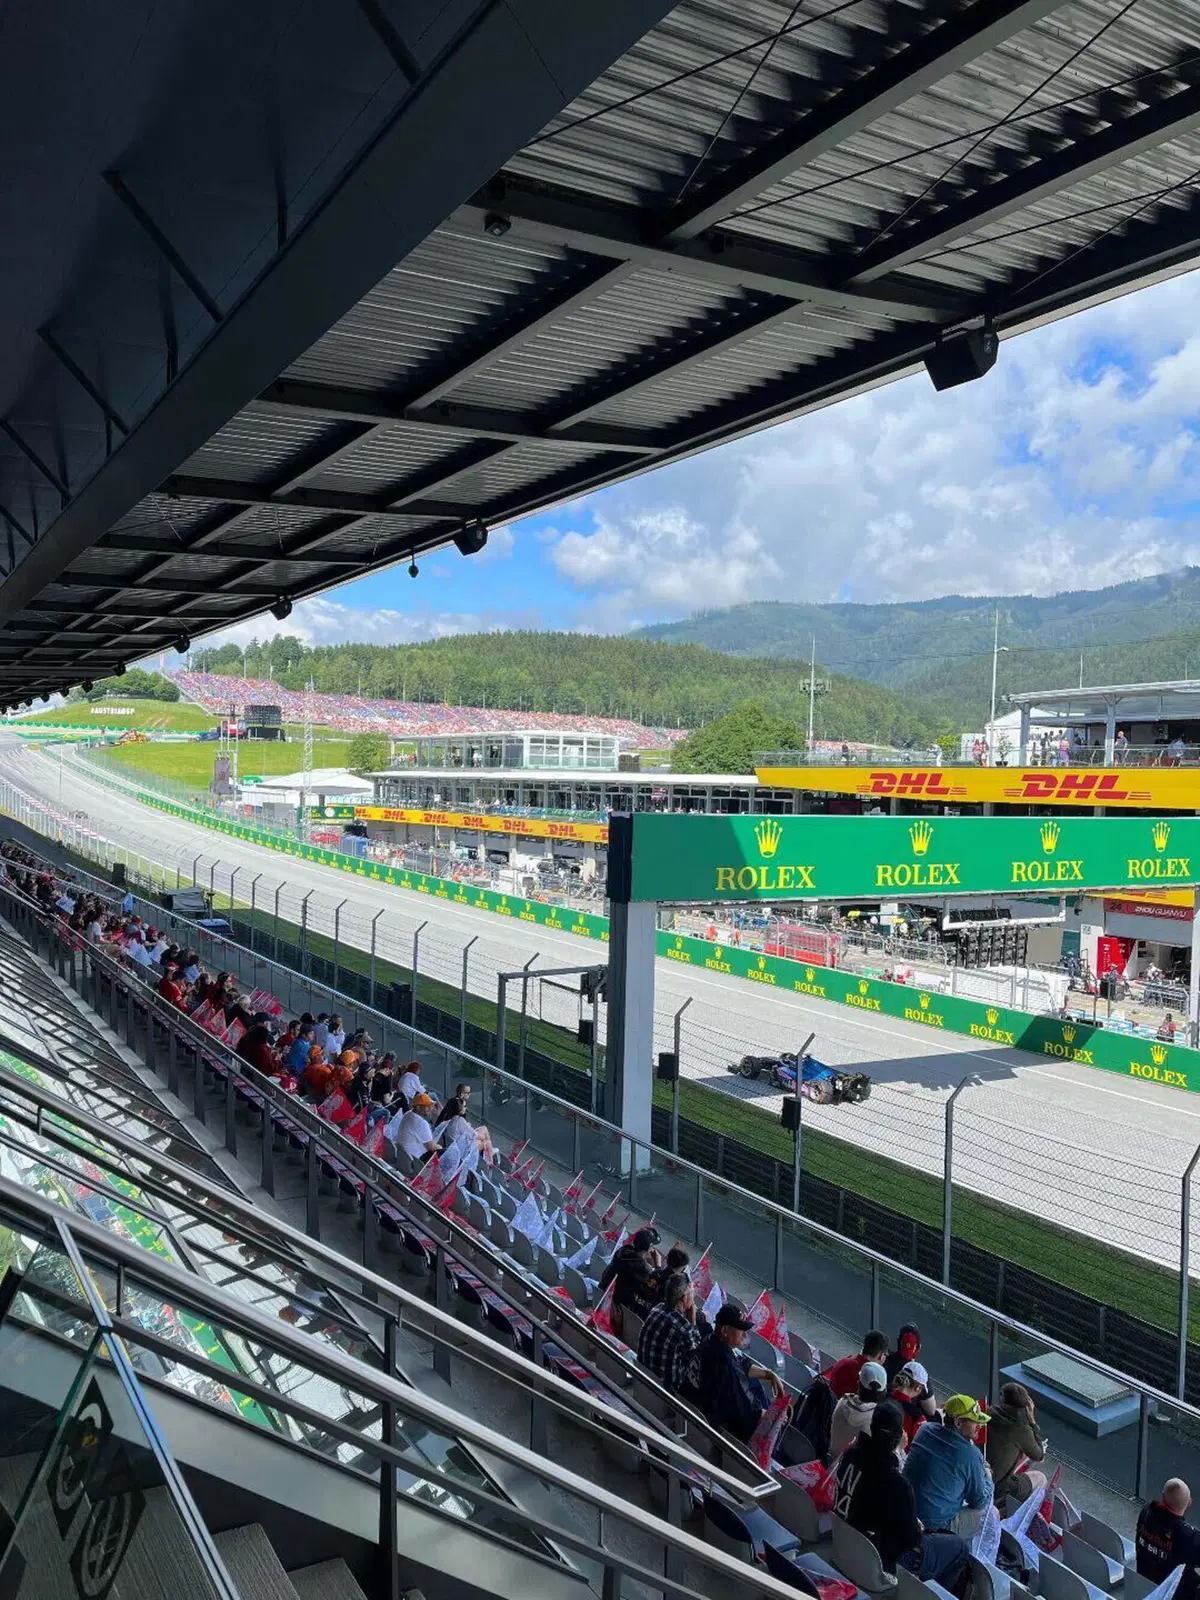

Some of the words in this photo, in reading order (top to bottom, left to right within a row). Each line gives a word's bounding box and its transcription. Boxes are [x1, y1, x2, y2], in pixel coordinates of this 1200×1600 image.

[868, 772, 950, 796] DHL
[1020, 774, 1129, 800] DHL
[383, 809, 407, 822] DHL
[423, 813, 450, 825] DHL
[463, 816, 487, 828] DHL
[503, 819, 529, 833] DHL
[548, 824, 579, 838] DHL
[876, 863, 960, 886] ROLEX
[1011, 860, 1084, 882] ROLEX
[1127, 858, 1191, 879] ROLEX
[716, 865, 815, 890] ROLEX
[1134, 906, 1155, 914] ZHOU
[667, 948, 690, 961] ROLEX
[705, 958, 731, 972] ROLEX
[747, 968, 776, 983] ROLEX
[794, 980, 826, 995] ROLEX
[845, 992, 881, 1009] ROLEX
[904, 1007, 944, 1026] ROLEX
[969, 1023, 1014, 1043] ROLEX
[1043, 1040, 1095, 1063] ROLEX
[1129, 1061, 1188, 1086] ROLEX
